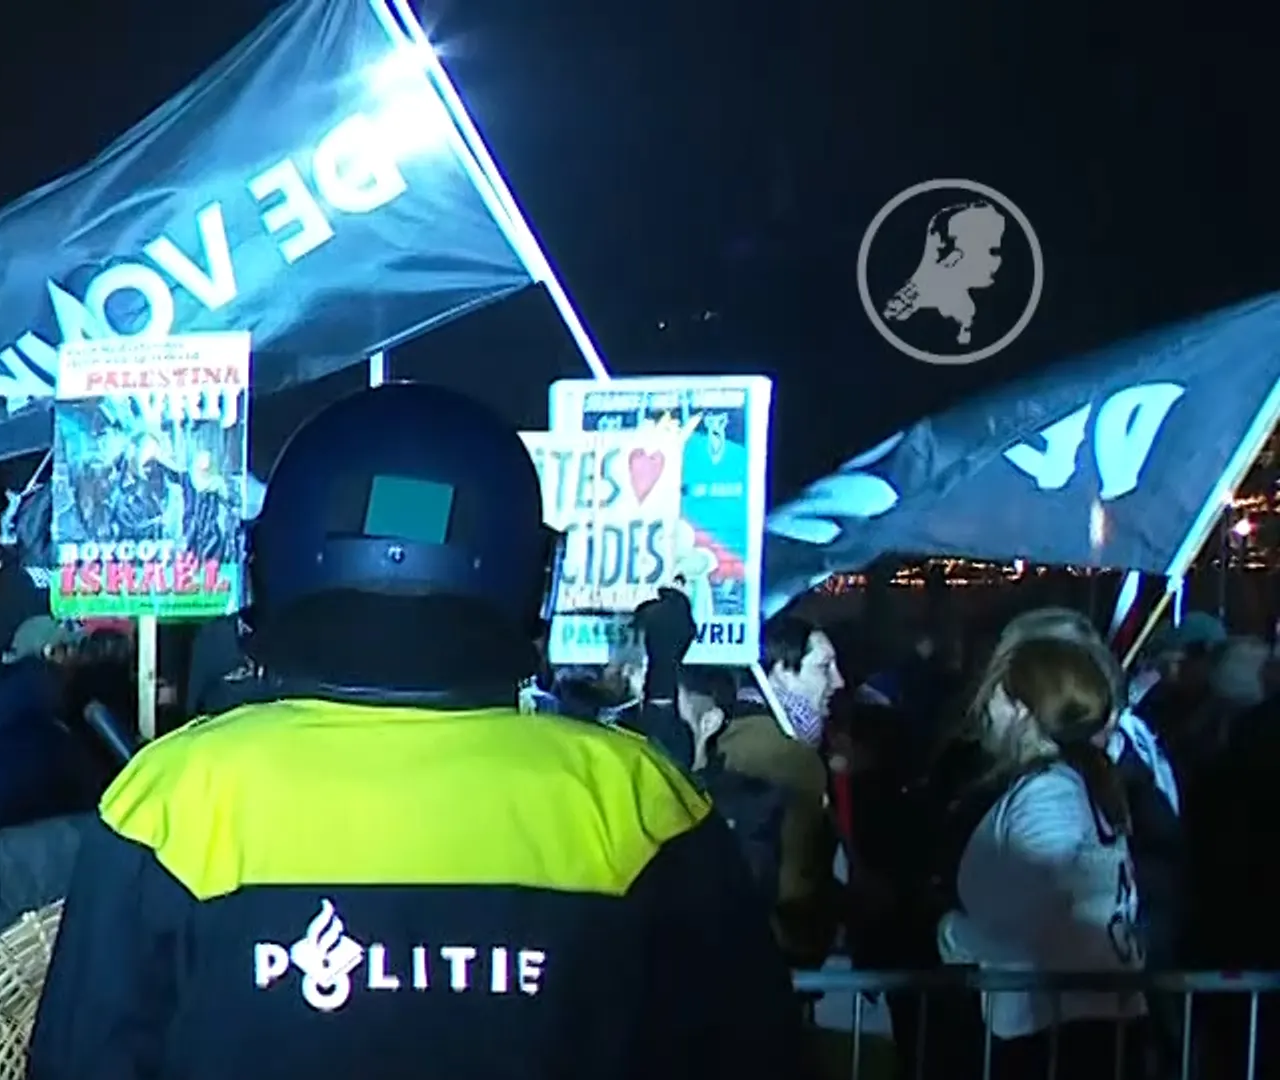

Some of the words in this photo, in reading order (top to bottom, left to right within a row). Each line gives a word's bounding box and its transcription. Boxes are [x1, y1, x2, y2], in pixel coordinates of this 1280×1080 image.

[86, 364, 241, 392] PALESTINA
[694, 622, 745, 646] VRIJ
[254, 898, 546, 1011] POLITIE
